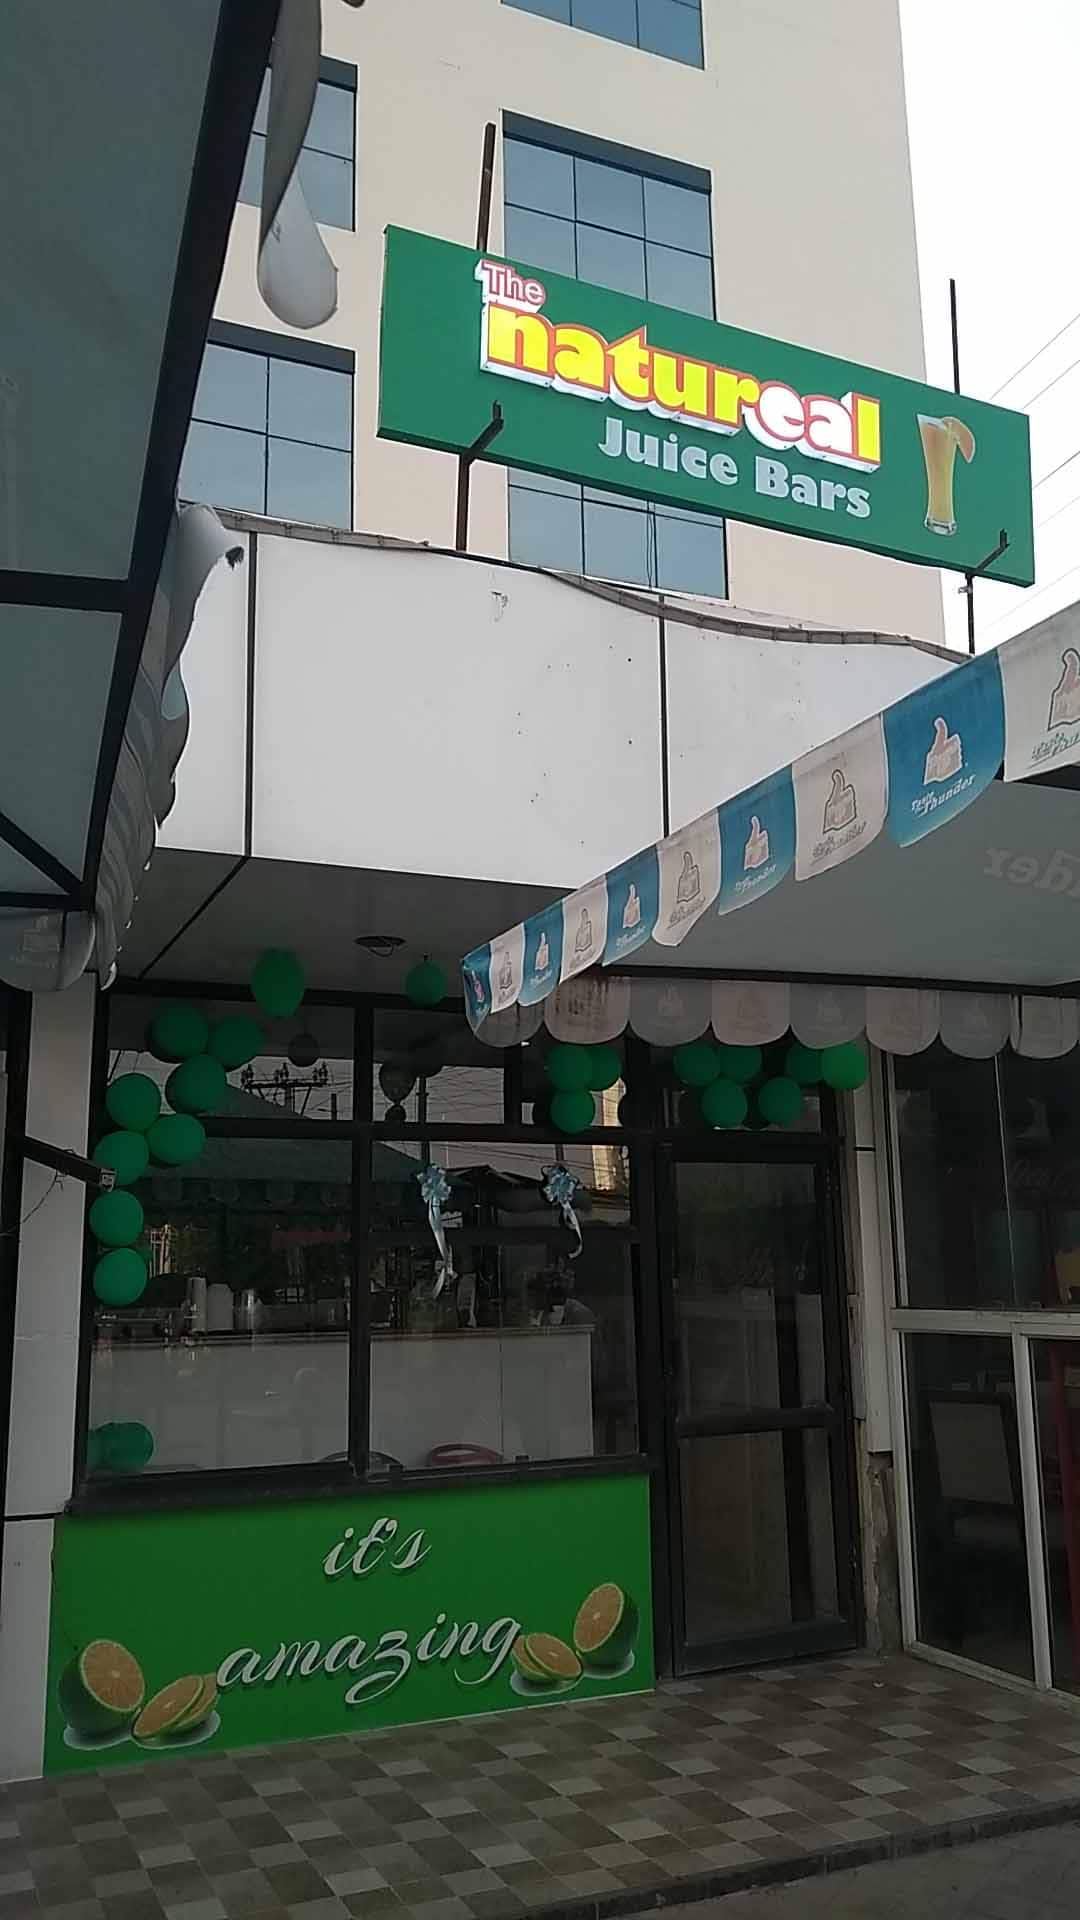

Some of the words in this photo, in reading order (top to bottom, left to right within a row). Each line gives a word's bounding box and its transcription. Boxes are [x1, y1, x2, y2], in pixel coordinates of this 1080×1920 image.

[480, 259, 547, 308] The
[480, 302, 880, 473] natureal
[598, 416, 739, 486] Juice
[755, 455, 871, 519] Bars
[322, 1517, 433, 1576] it's
[217, 1613, 522, 1705] amazing
